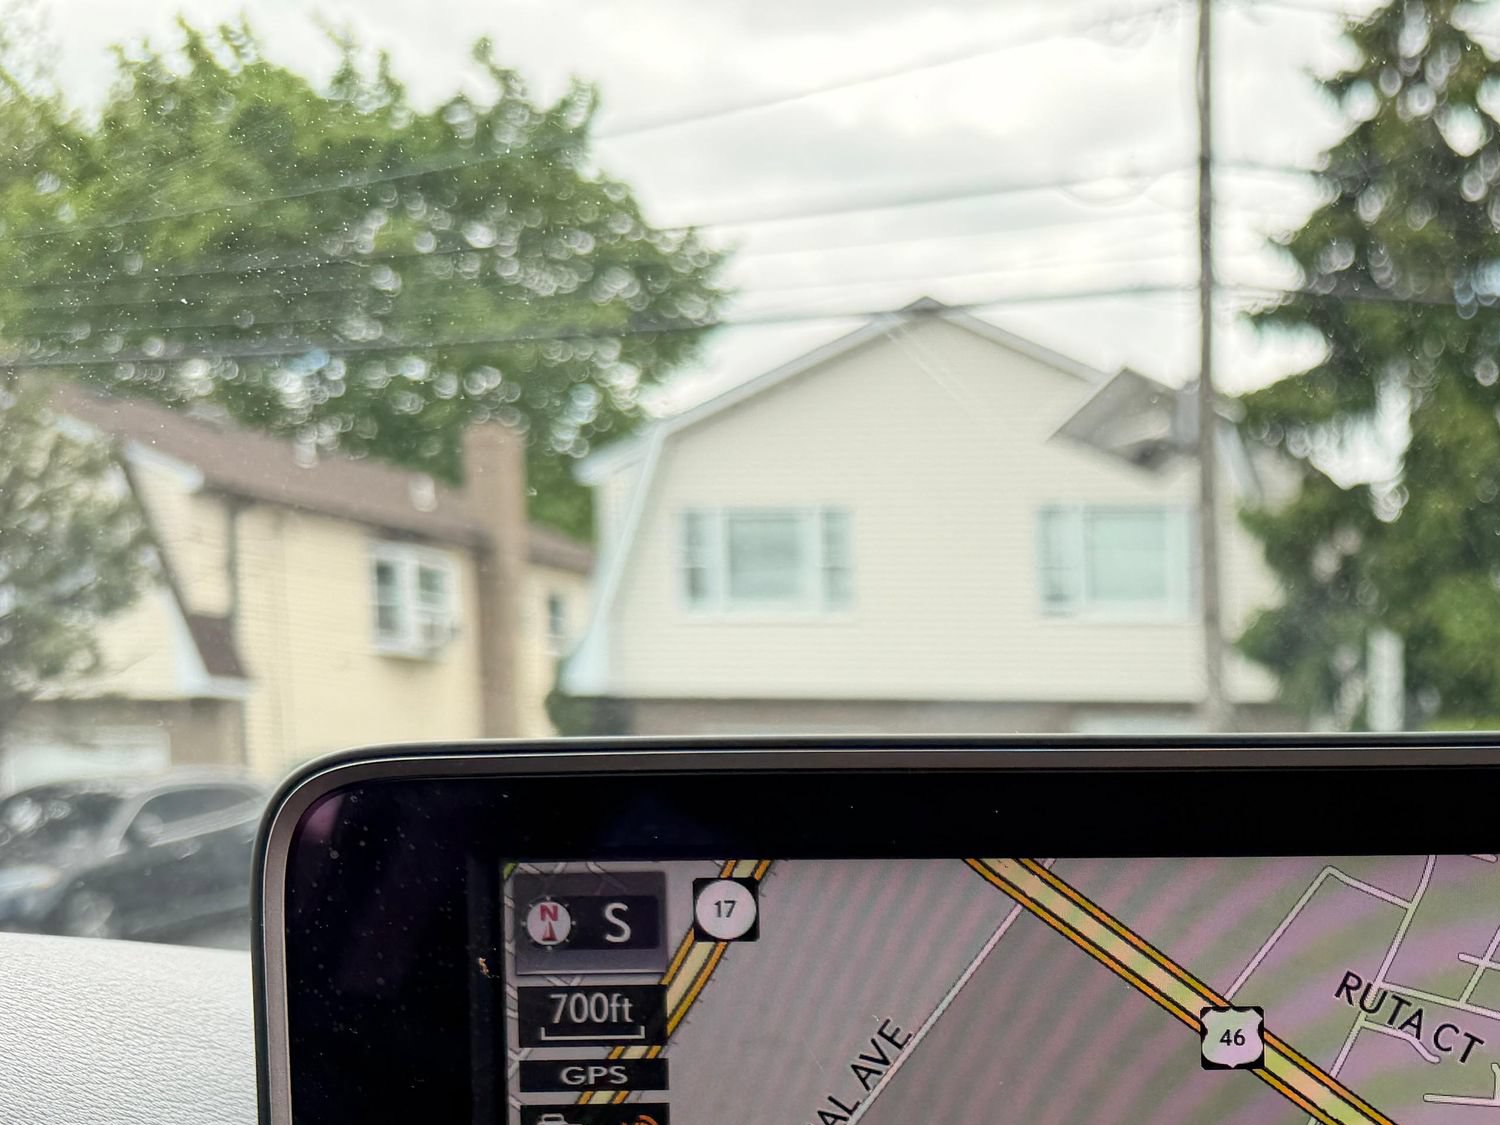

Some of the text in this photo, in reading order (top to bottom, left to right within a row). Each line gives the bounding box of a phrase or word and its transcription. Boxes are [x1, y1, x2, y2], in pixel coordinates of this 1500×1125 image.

[604, 902, 631, 943] S
[713, 899, 736, 919] 17
[549, 991, 634, 1024] 700ft
[1333, 970, 1485, 1064] RUTA CT
[849, 1017, 913, 1091] AVE
[1220, 1029, 1246, 1048] 46
[561, 1065, 629, 1086] GPS
